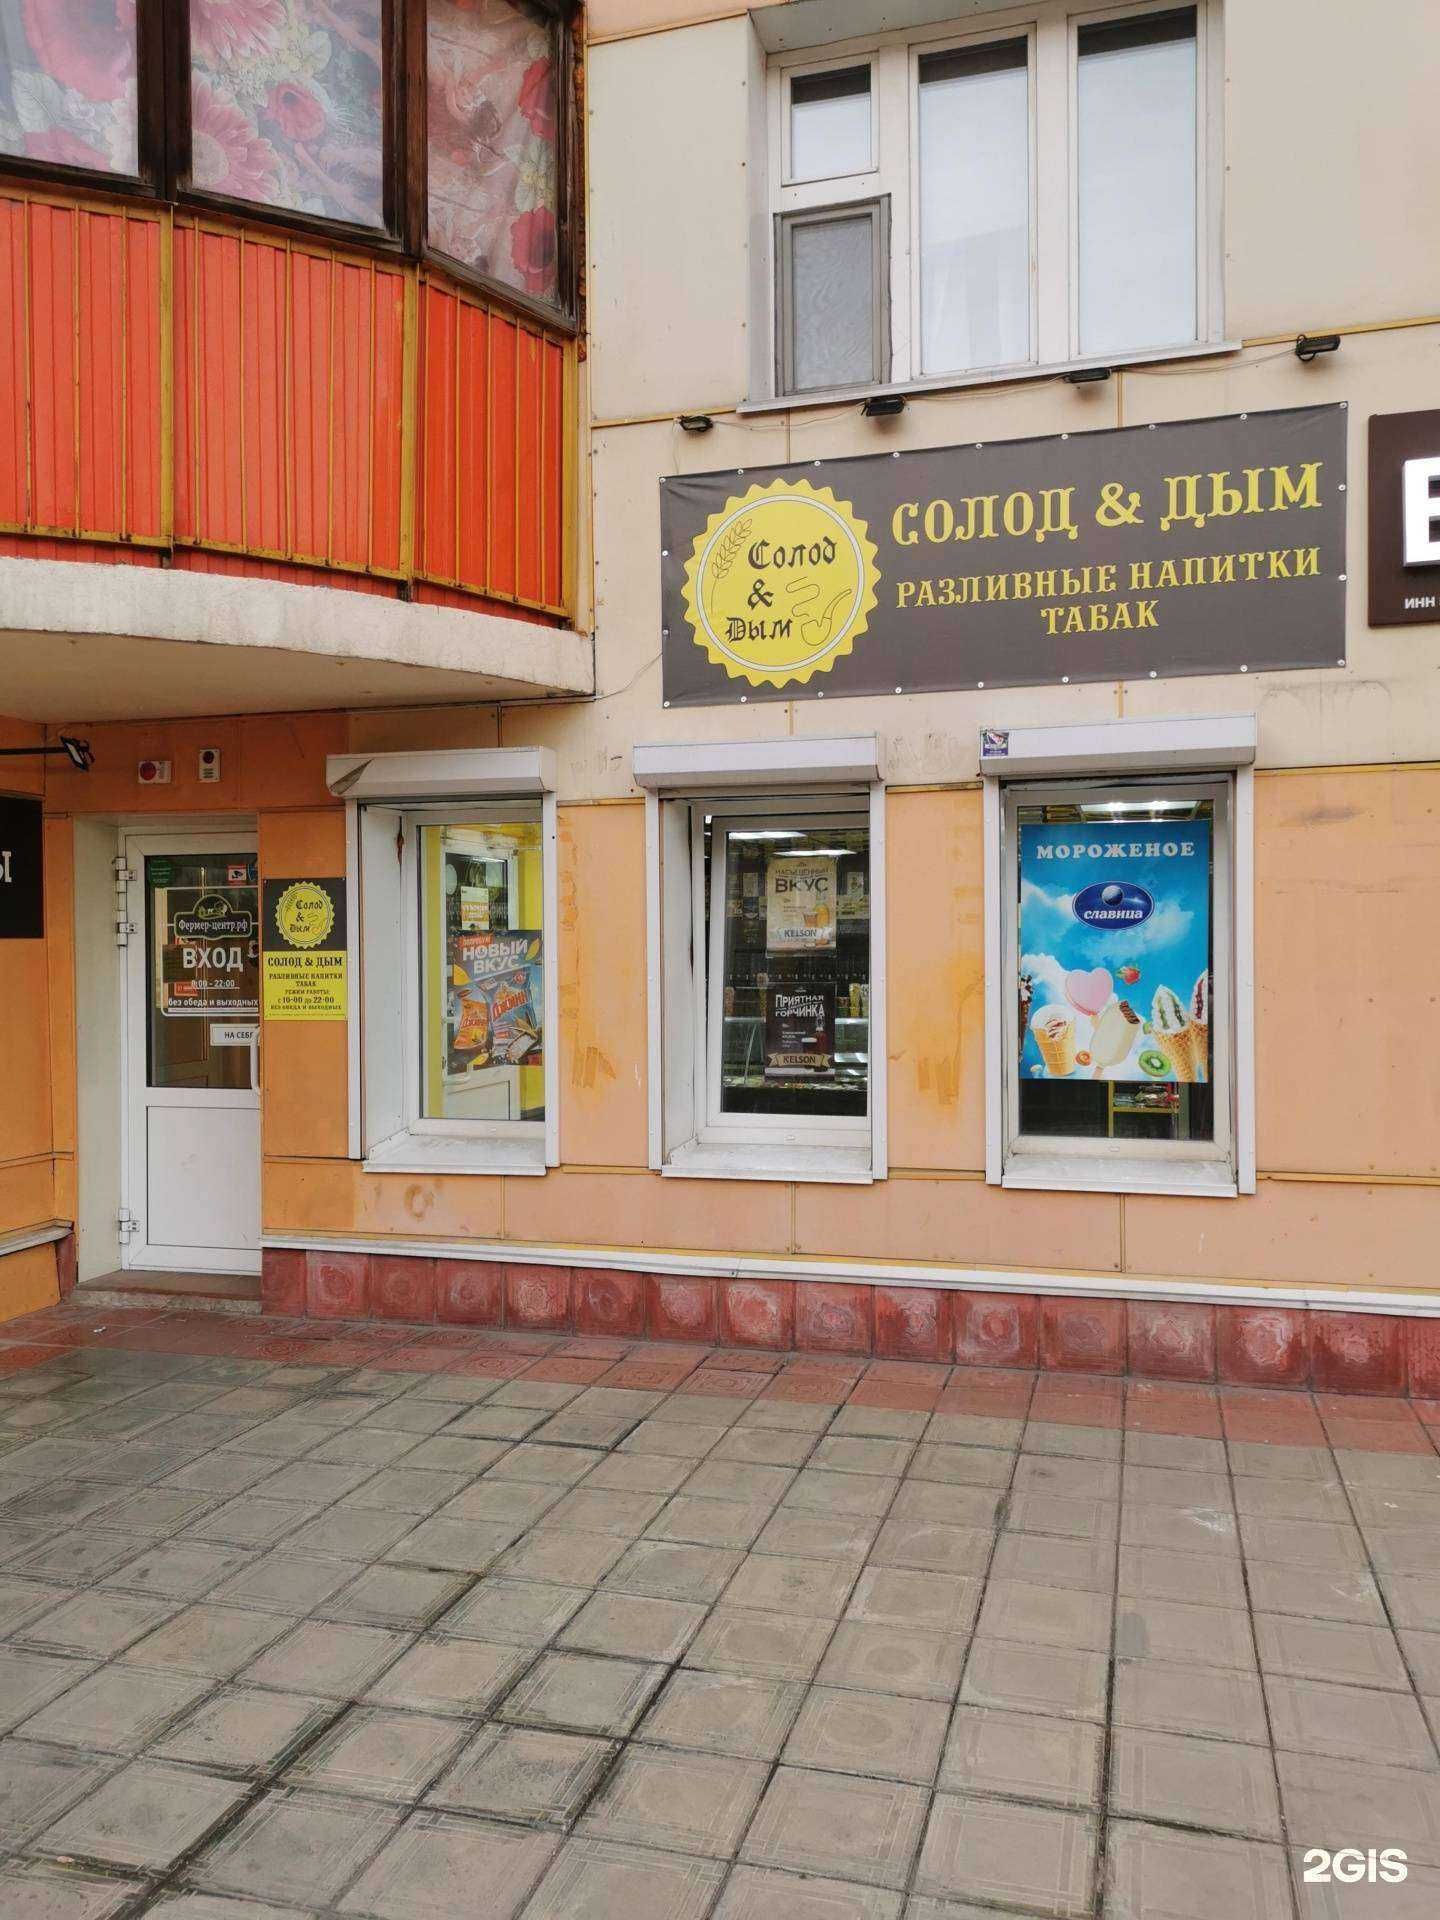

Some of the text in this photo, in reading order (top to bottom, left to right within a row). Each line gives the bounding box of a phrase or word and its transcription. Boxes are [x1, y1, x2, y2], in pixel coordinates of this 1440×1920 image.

[891, 461, 1324, 546] СОЛОД & ДЫМ
[747, 535, 838, 570] Солод
[895, 546, 1321, 609] РАЗЛИВНЫЕ НАПИТКИ
[746, 577, 775, 611] &
[1404, 596, 1436, 609] ИНН
[1039, 599, 1160, 636] ТАБАК
[724, 615, 794, 644] Дым
[1036, 842, 1195, 860] МОРОЖЕНОЕ
[775, 877, 829, 893] ВКУС
[1083, 908, 1143, 920] славица
[178, 919, 248, 933] Фермер-центр.рф
[784, 928, 817, 938] KELSON
[462, 937, 528, 961] НОВЫЙ
[182, 946, 244, 973] ВХОД
[268, 957, 302, 968] СОЛОД
[316, 956, 344, 968] ДЫМ
[473, 954, 519, 974] ВКУС
[168, 997, 182, 1007] без
[183, 997, 208, 1008] обеда
[216, 999, 259, 1008] выходных
[775, 994, 825, 1008] ПРИЯТНАЯ
[775, 1003, 826, 1017] ГОРЧИНКА
[224, 1031, 235, 1039] НА
[783, 1055, 816, 1064] KELSON
